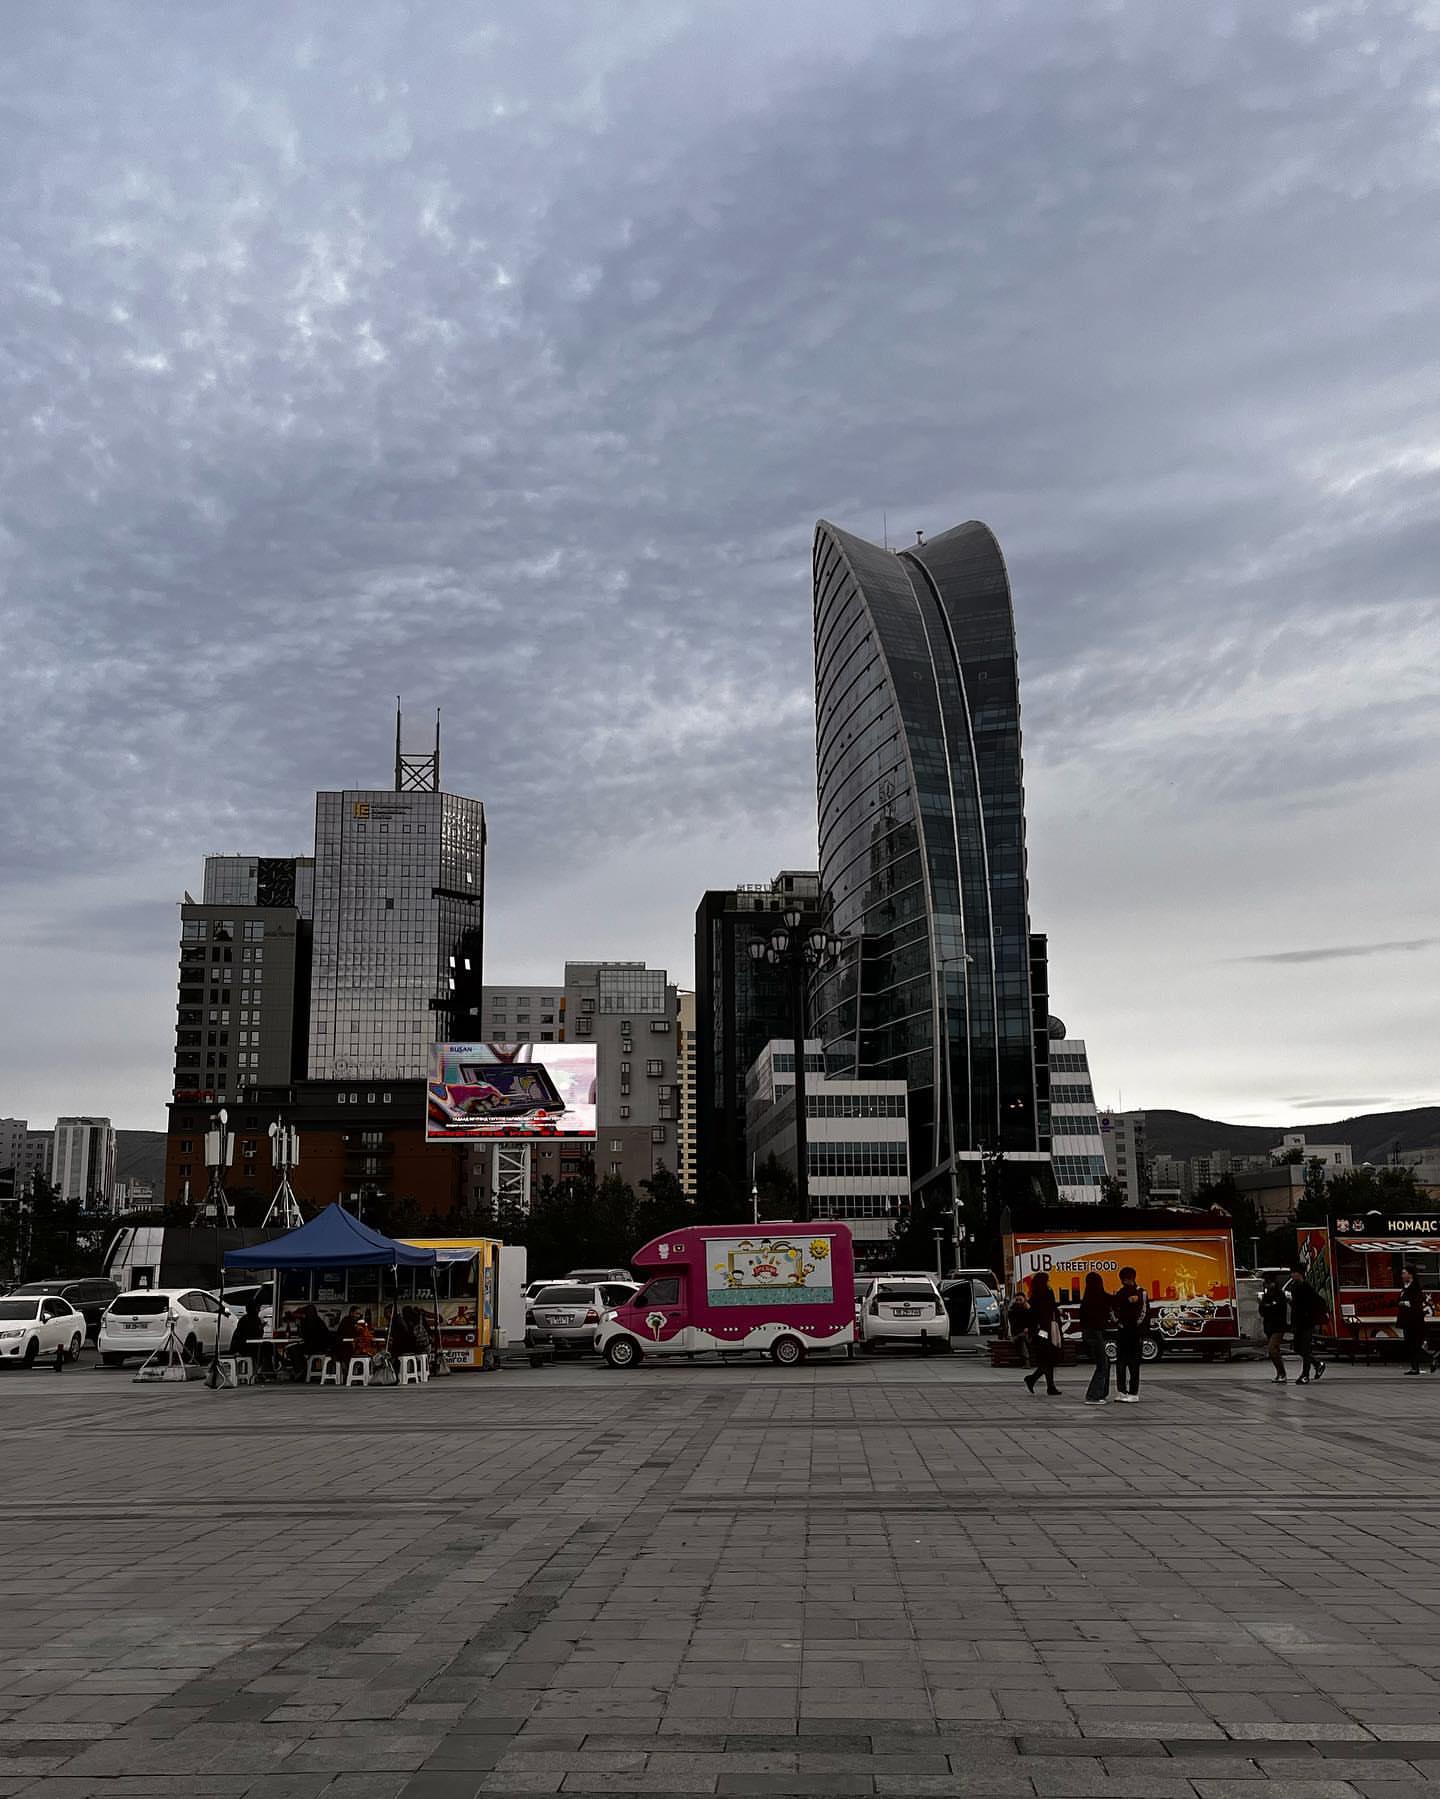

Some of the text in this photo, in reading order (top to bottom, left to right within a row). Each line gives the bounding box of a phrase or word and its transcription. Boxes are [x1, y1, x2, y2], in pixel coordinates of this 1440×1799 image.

[1030, 1254, 1117, 1272] UB STREET FOOD
